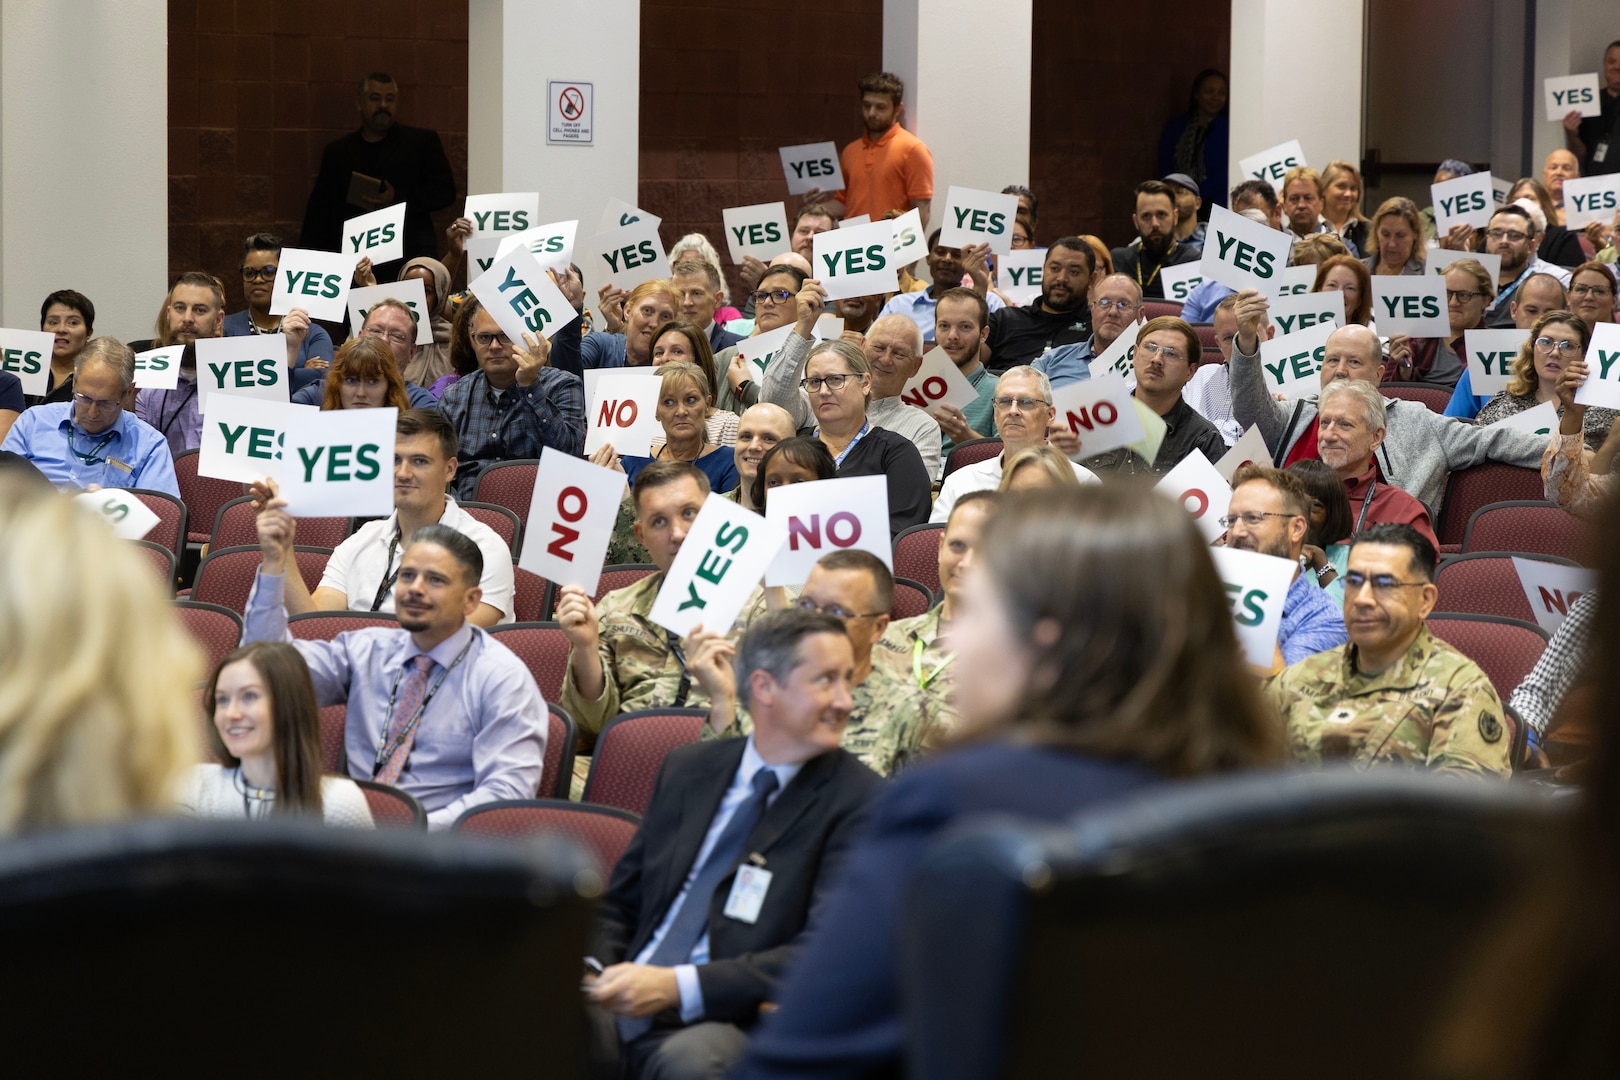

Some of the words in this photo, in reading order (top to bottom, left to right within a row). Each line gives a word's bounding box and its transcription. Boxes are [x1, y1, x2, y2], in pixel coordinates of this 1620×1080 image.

[1552, 88, 1593, 106] YES
[790, 158, 834, 178] YES
[1441, 191, 1486, 215] YES
[1573, 191, 1616, 210] YES
[474, 210, 528, 231] YES
[734, 222, 781, 245] YES
[955, 208, 1006, 235] YES
[351, 223, 395, 252] YES
[531, 236, 564, 253] ES
[604, 240, 657, 271] YES
[823, 245, 886, 277] YES
[1217, 232, 1275, 278] YES
[286, 270, 342, 298] YES
[1008, 268, 1041, 286] YE
[497, 266, 552, 332] YES
[1383, 296, 1440, 318] YES
[2, 349, 41, 374] ES
[135, 356, 169, 370] ES
[209, 359, 278, 389] YES
[1477, 352, 1514, 375] YE
[902, 376, 947, 407] NO
[597, 399, 638, 428] NO
[1066, 401, 1118, 435] NO
[297, 443, 380, 483] YES
[1180, 488, 1210, 518] O
[548, 486, 588, 561] NO
[788, 512, 861, 551] NO
[678, 521, 749, 612] YES
